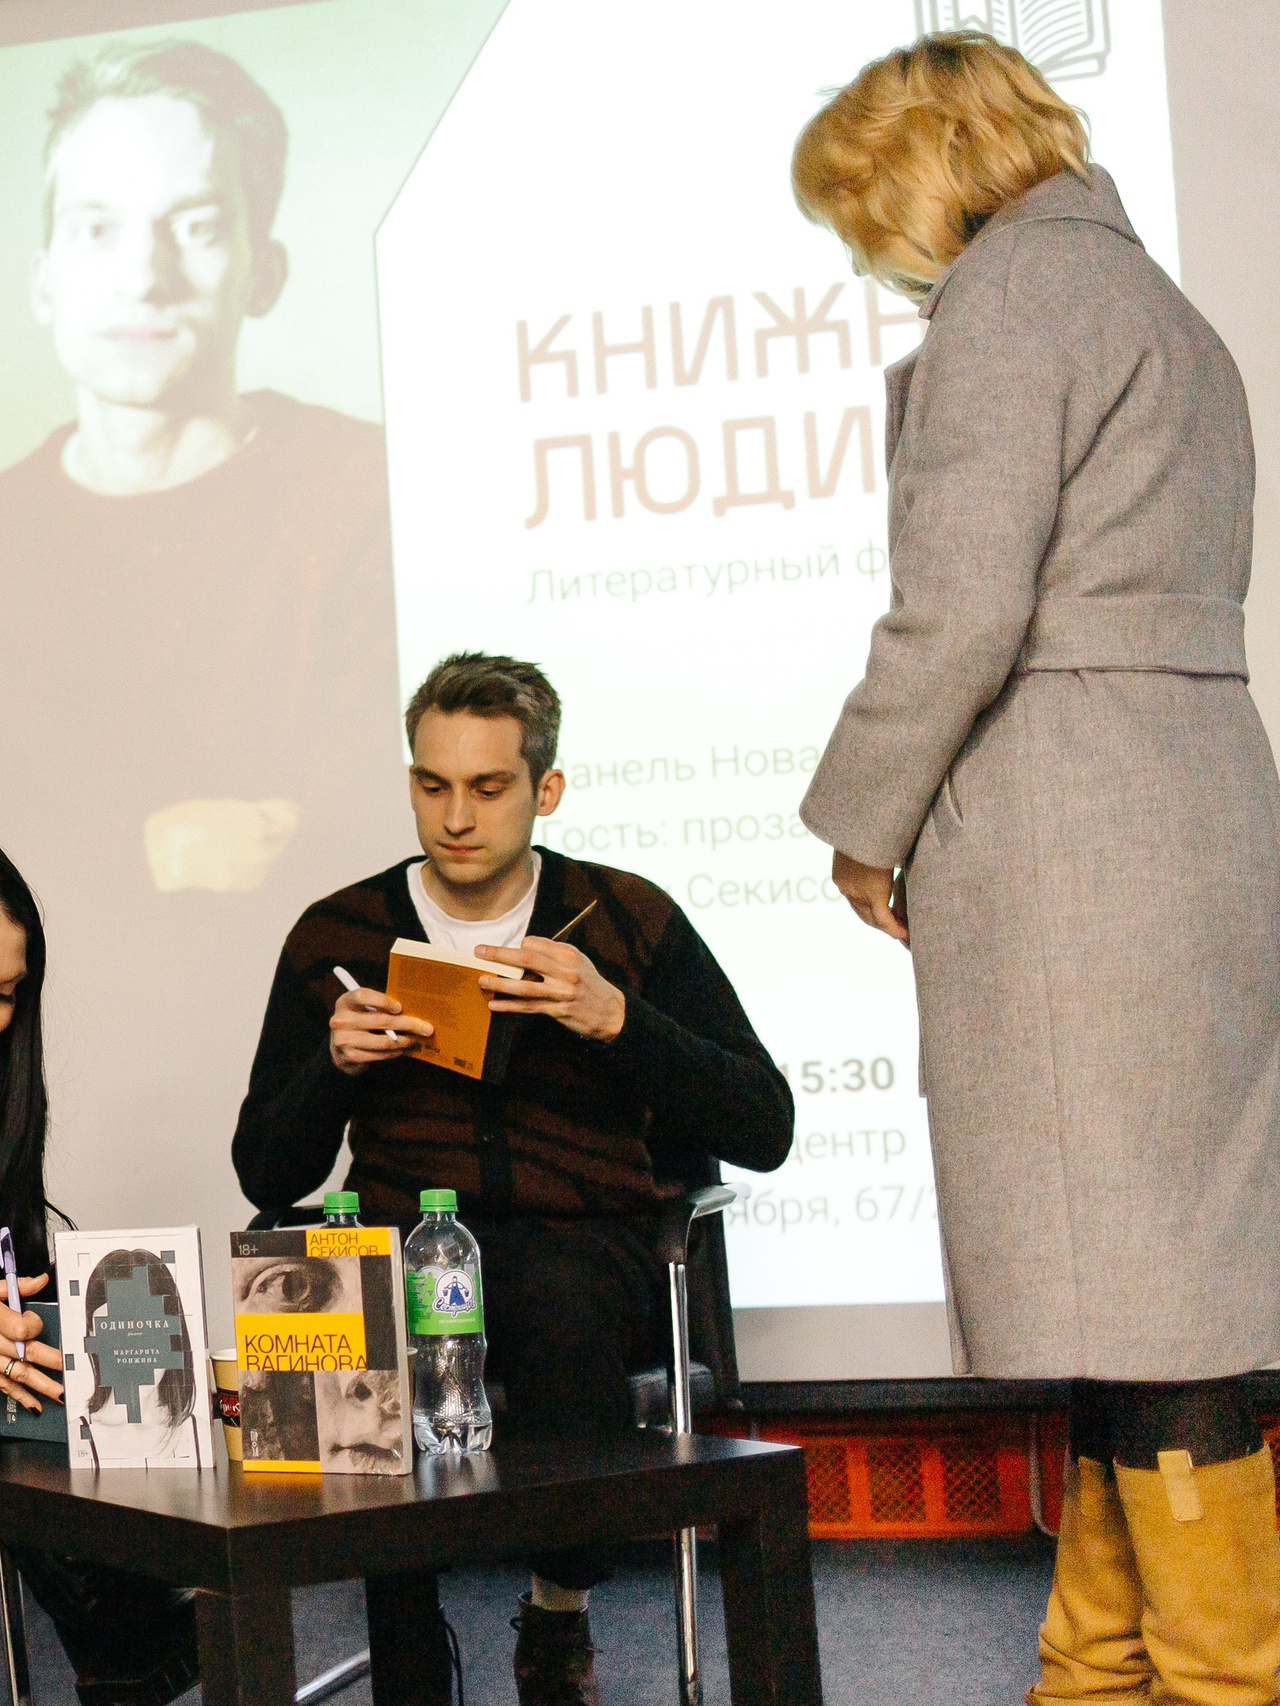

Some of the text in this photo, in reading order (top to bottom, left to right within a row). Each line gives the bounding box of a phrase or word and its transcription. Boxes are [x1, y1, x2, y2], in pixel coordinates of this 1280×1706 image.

[525, 405, 876, 529] ЛЮДИ
[526, 543, 840, 604] Литературный
[540, 819, 668, 854] Гость:
[855, 1183, 937, 1222] 67/
[310, 1233, 358, 1246] АНТОН
[238, 1244, 259, 1256] 18+
[310, 1245, 379, 1257] СЕКИСОВ
[100, 1320, 169, 1330] ОДИНОЧКА
[245, 1334, 352, 1353] КОМНАТА
[246, 1354, 367, 1371] ВАГИНОВА
